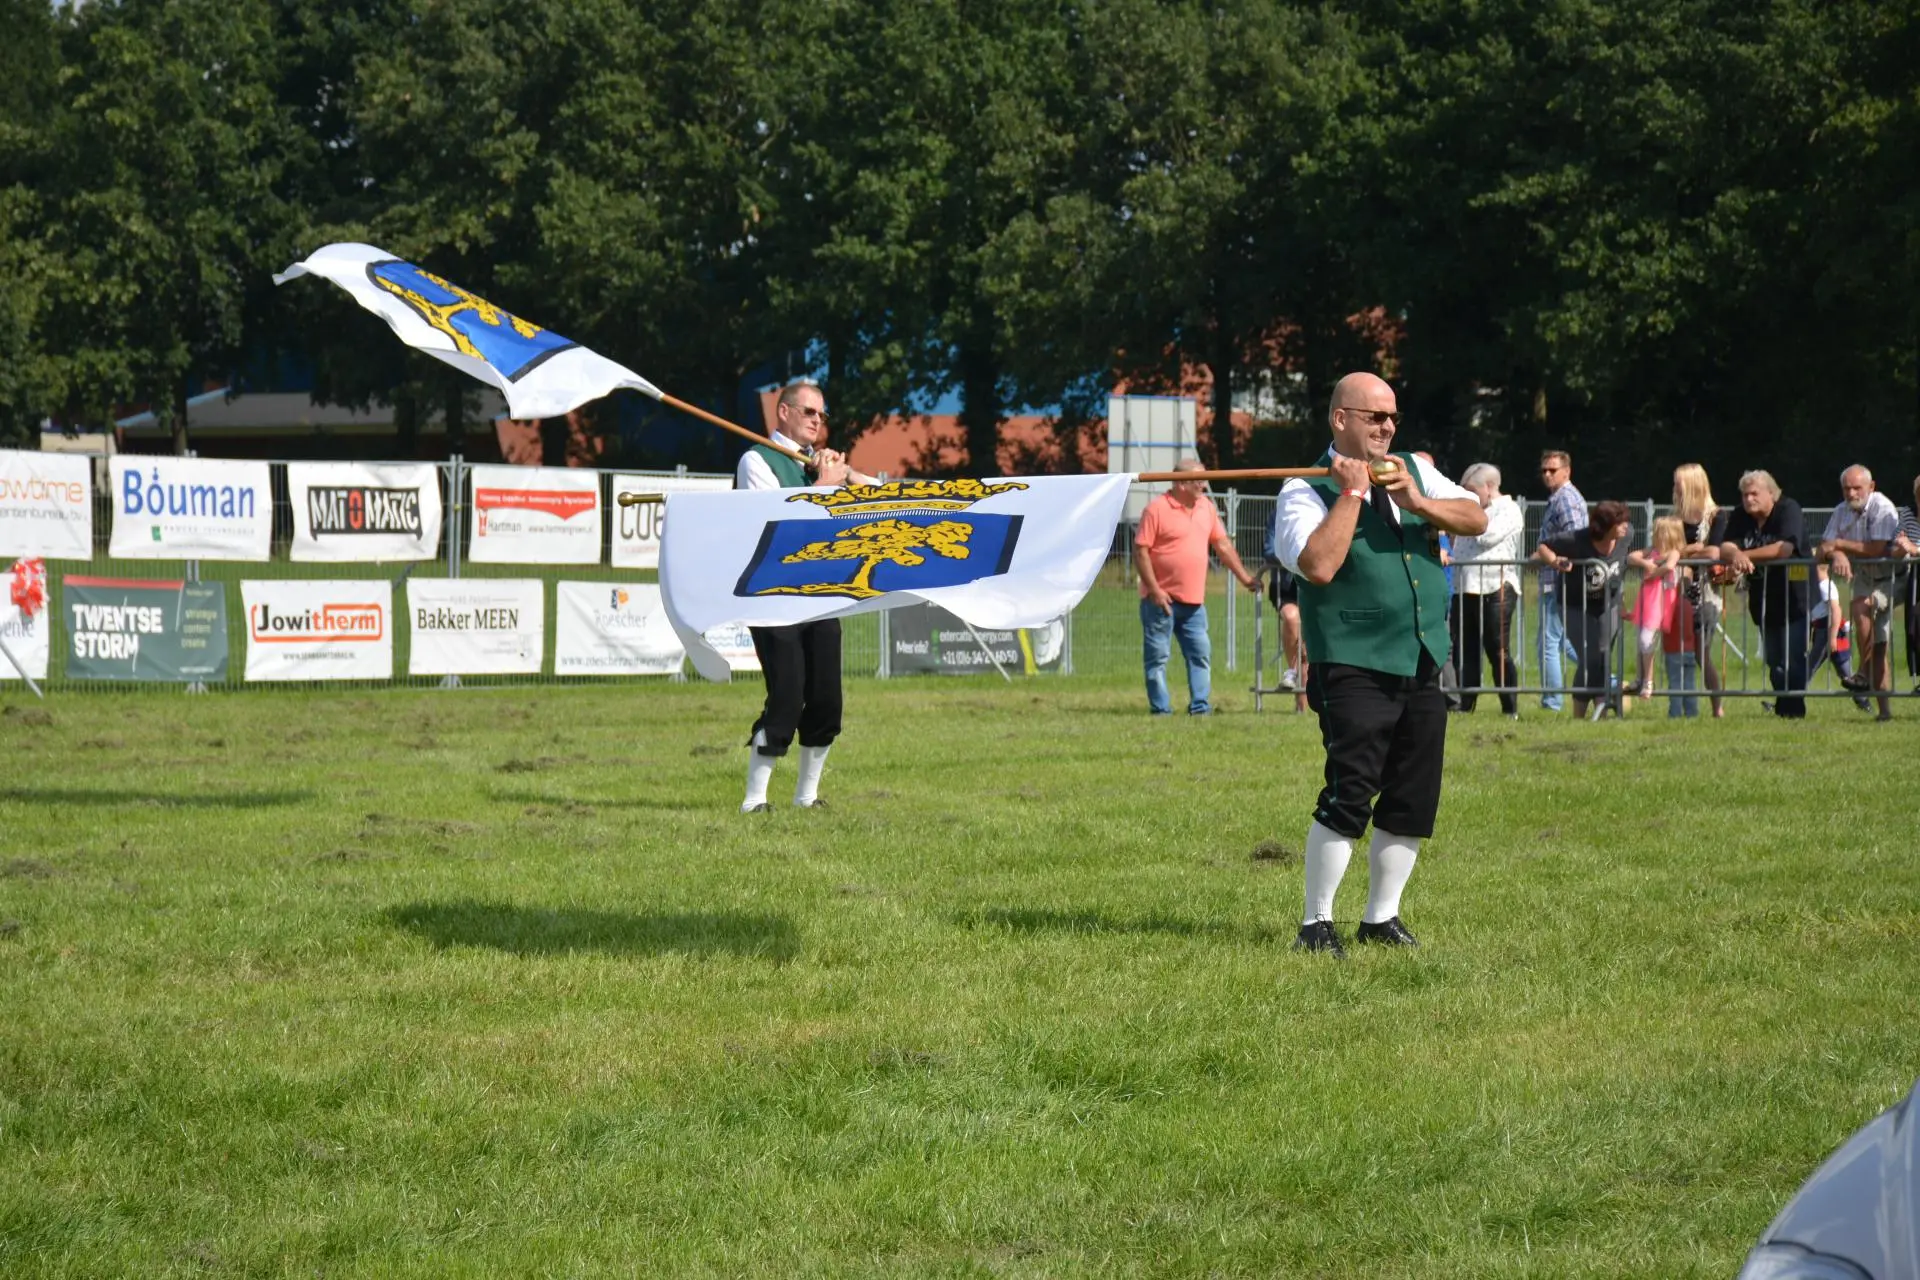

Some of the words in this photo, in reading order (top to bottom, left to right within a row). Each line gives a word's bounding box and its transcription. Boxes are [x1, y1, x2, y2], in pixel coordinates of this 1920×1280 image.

[123, 468, 254, 518] Bouman
[72, 603, 163, 633] TWENTSE
[257, 604, 376, 631] Jowitherm
[417, 607, 471, 630] Bakker
[474, 608, 519, 630] MEEN
[74, 631, 139, 660] STORM
